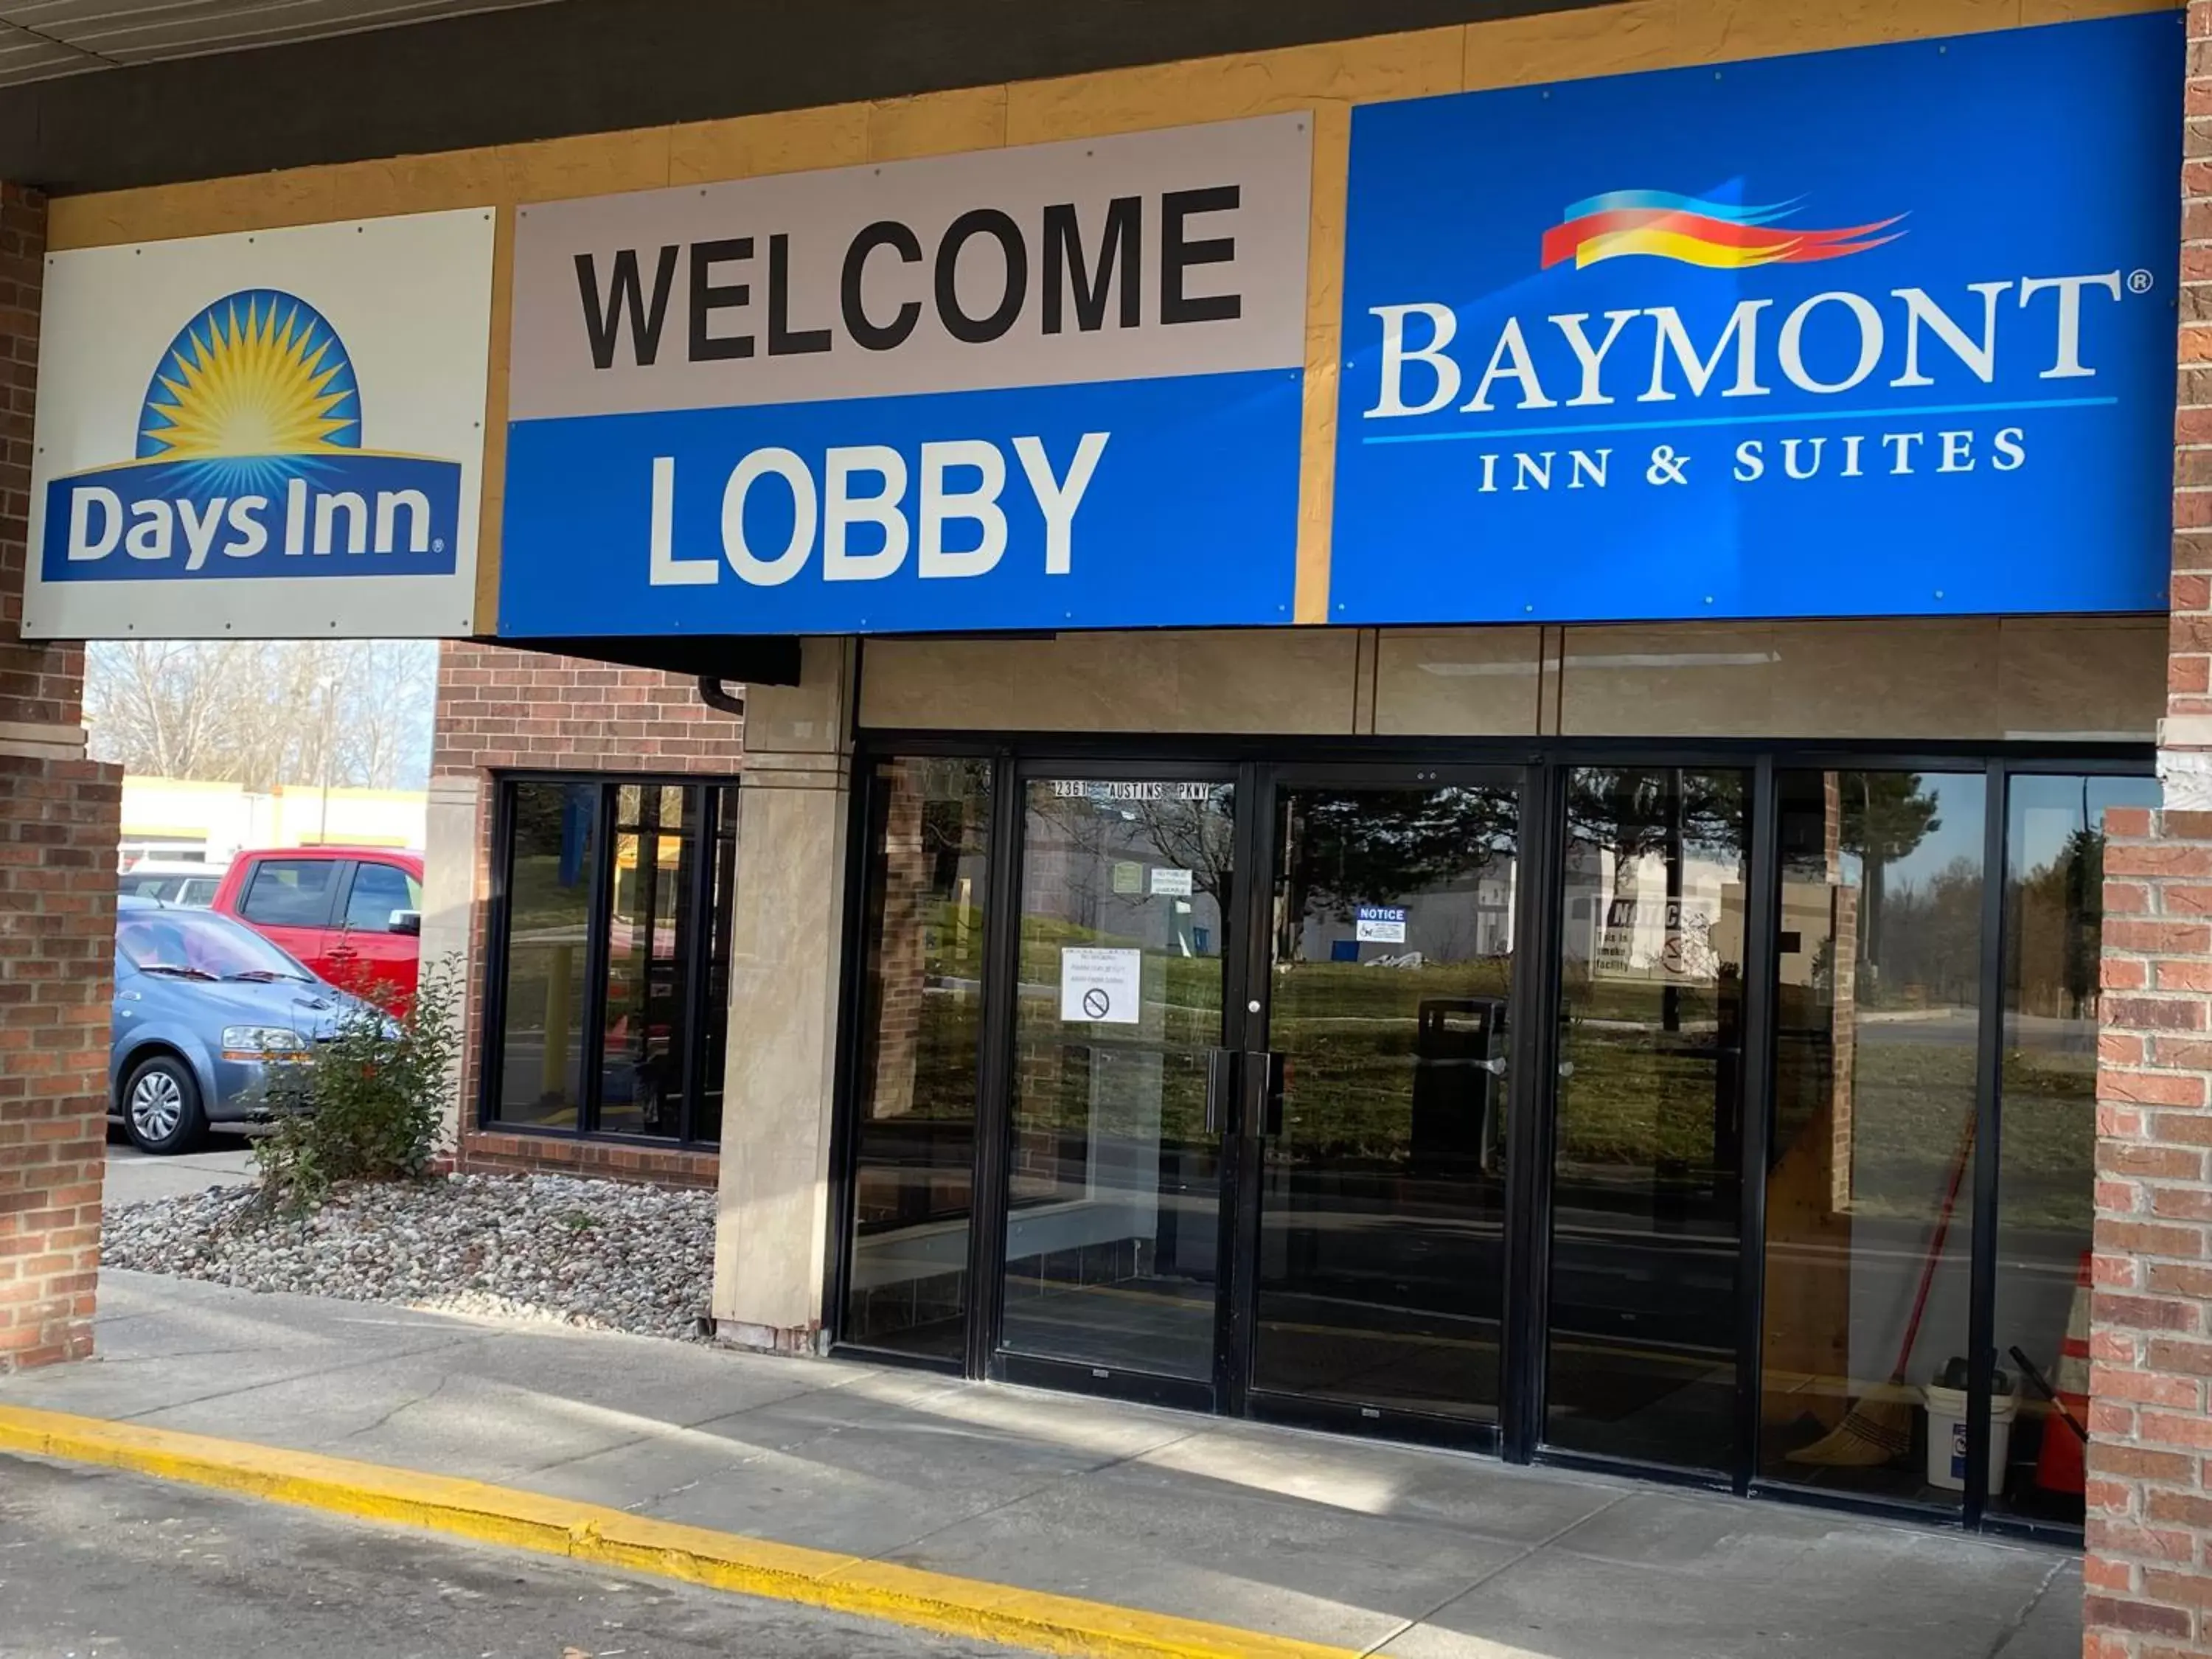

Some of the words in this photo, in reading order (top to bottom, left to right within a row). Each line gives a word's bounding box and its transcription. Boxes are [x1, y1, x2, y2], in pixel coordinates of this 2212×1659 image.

[574, 185, 1242, 370] WELCOME
[1477, 448, 1613, 493] INN
[1645, 444, 1689, 485] &
[1733, 426, 2028, 481] SUITES
[67, 487, 269, 571] Days
[649, 431, 1112, 588] LOBBY
[1055, 781, 1088, 796] 2361
[1109, 783, 1161, 799] AUSTINS
[1179, 784, 1208, 799] PKWY
[1360, 908, 1405, 921] NOTICE
